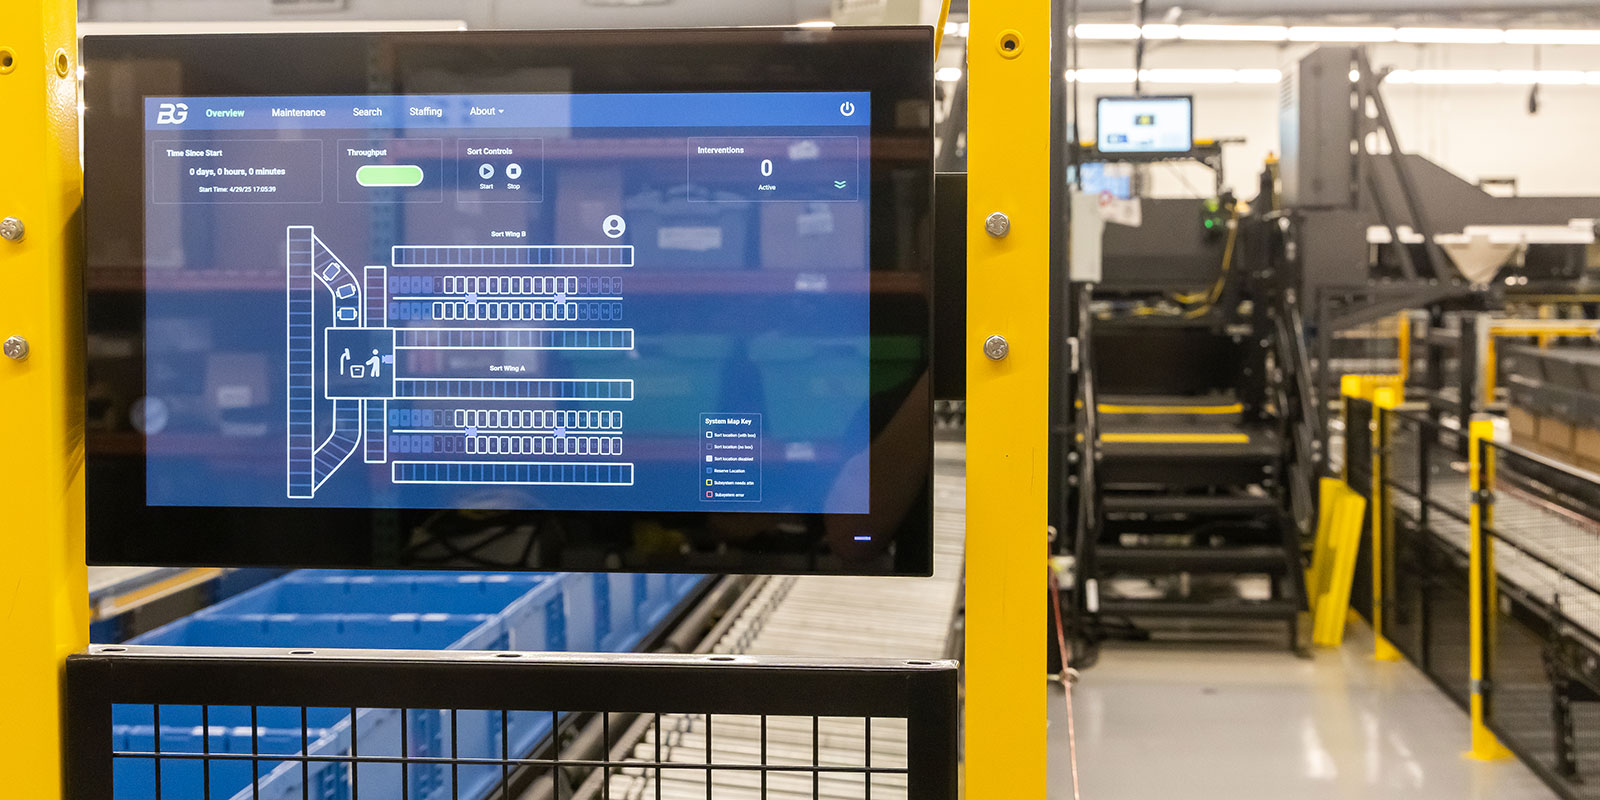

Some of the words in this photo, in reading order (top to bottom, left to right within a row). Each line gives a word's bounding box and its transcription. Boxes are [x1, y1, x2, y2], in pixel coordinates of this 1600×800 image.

[157, 103, 188, 124] BG
[206, 109, 245, 117] Overview
[272, 108, 326, 117] Maintenance
[353, 108, 382, 117] Search
[409, 106, 443, 118] Staffing
[470, 106, 496, 116] About
[347, 148, 387, 157] Throughput
[761, 159, 773, 176] 0
[196, 168, 216, 177] days,
[224, 168, 247, 176] hours,
